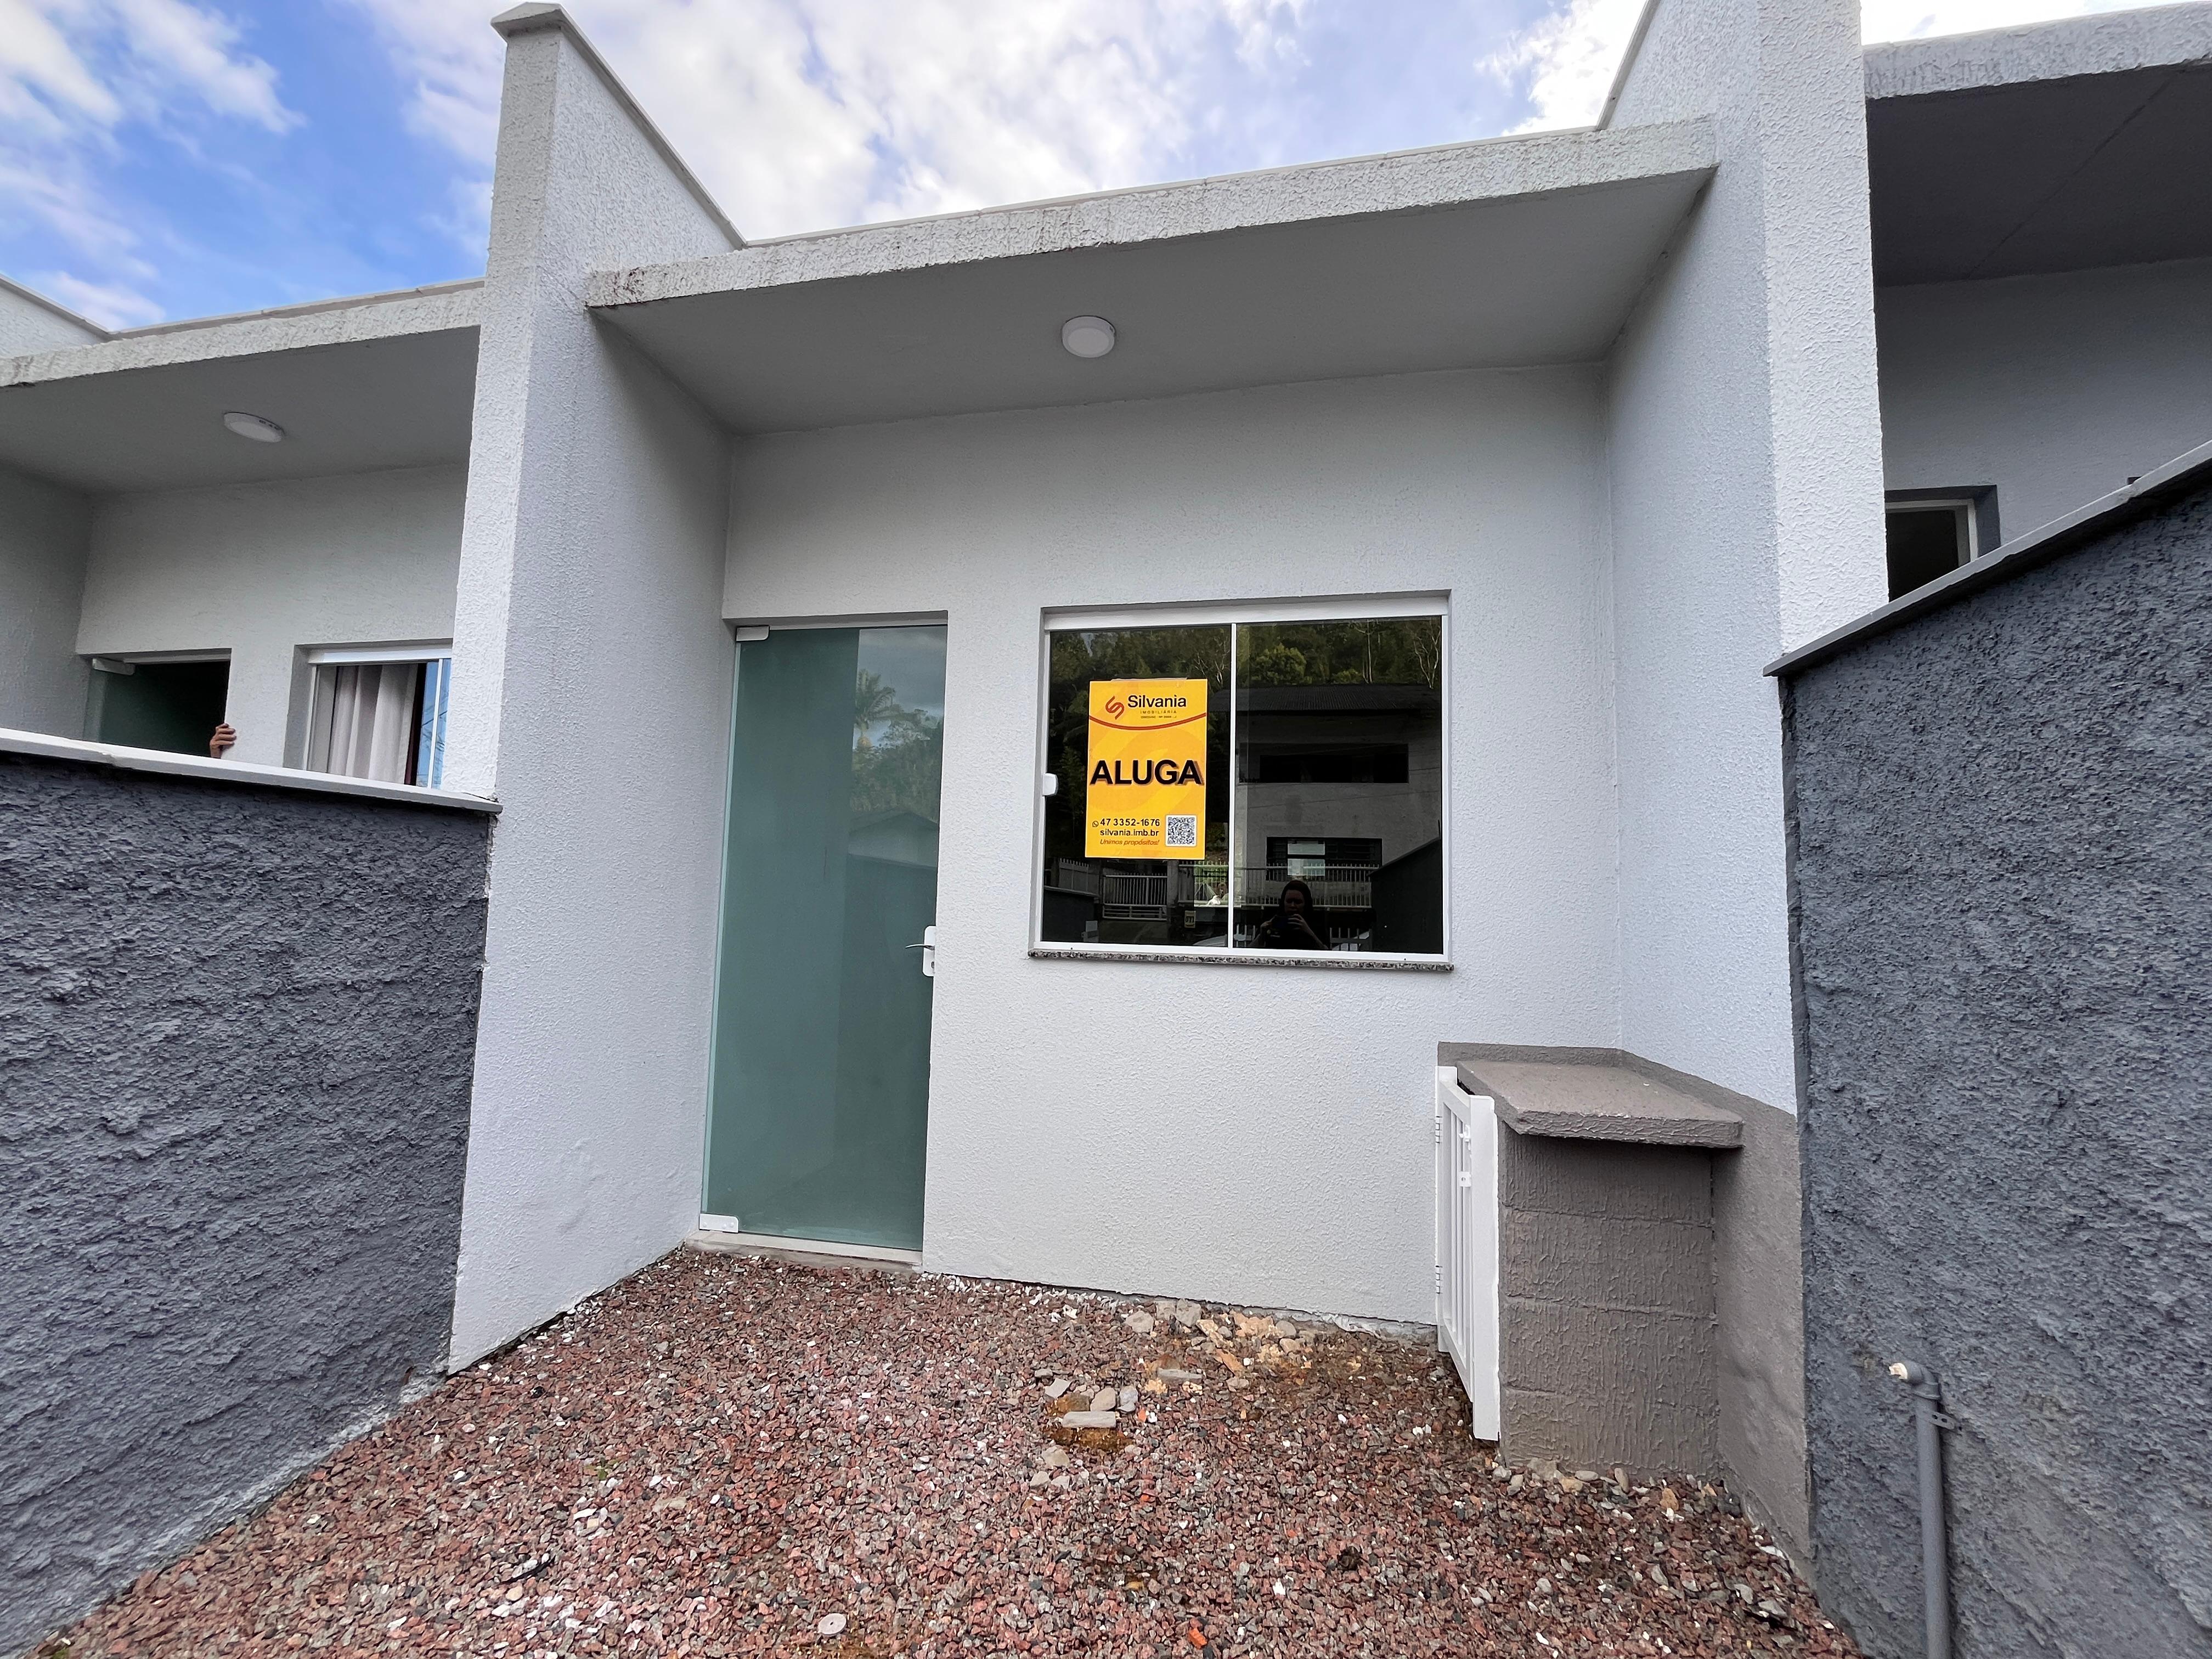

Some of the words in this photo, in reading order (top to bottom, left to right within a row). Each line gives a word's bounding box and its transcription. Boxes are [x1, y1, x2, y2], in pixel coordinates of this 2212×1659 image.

[1127, 695, 1187, 708] Silvania
[1090, 759, 1205, 785] ALUGA
[1100, 818, 1111, 826] 47
[1113, 818, 1160, 827] 3352-1676
